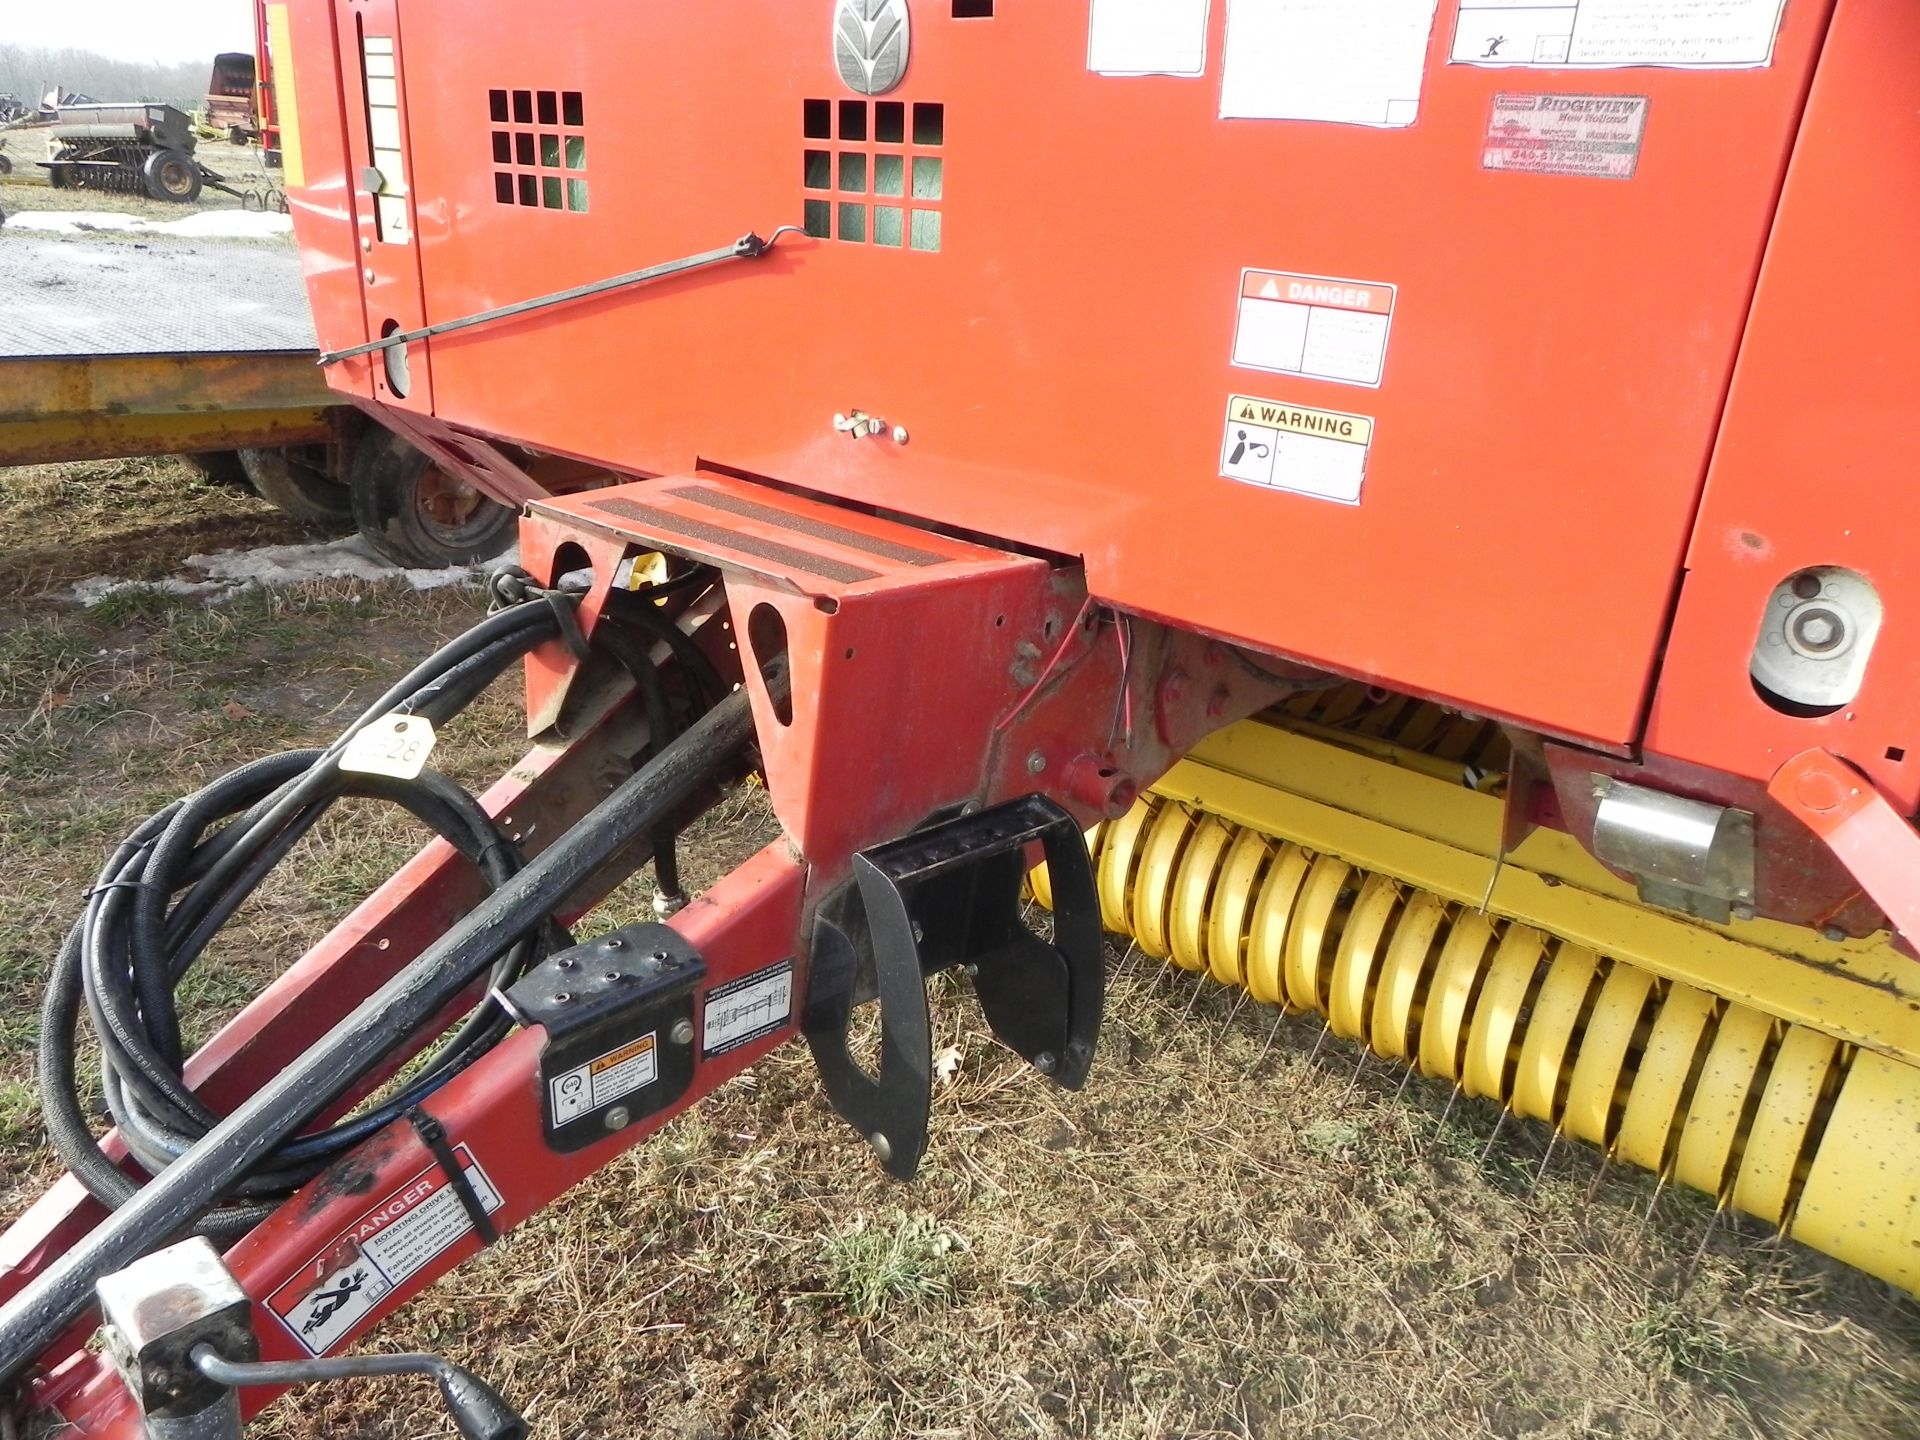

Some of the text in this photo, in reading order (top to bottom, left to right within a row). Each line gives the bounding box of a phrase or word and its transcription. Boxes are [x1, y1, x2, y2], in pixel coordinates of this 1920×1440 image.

[1538, 97, 1640, 113] RIDGEVIEW
[1559, 113, 1628, 124] New Holland
[1288, 282, 1370, 307] DANGER
[1261, 407, 1353, 436] WARNING
[610, 1041, 648, 1062] WARNING
[565, 1081, 578, 1089] 540
[374, 1193, 446, 1245] ROTATING DRIVE
[383, 1237, 402, 1254] Keep
[403, 1228, 412, 1240] all
[413, 1212, 438, 1234] shields
[439, 1201, 453, 1213] and
[386, 1249, 414, 1273] Failure
[415, 1242, 423, 1254] to
[424, 1223, 452, 1245] comply
[453, 1211, 467, 1223] will
[388, 1235, 418, 1258] serviced
[419, 1225, 433, 1238] and
[433, 1220, 440, 1229] in
[393, 1226, 462, 1279] in death or serious
